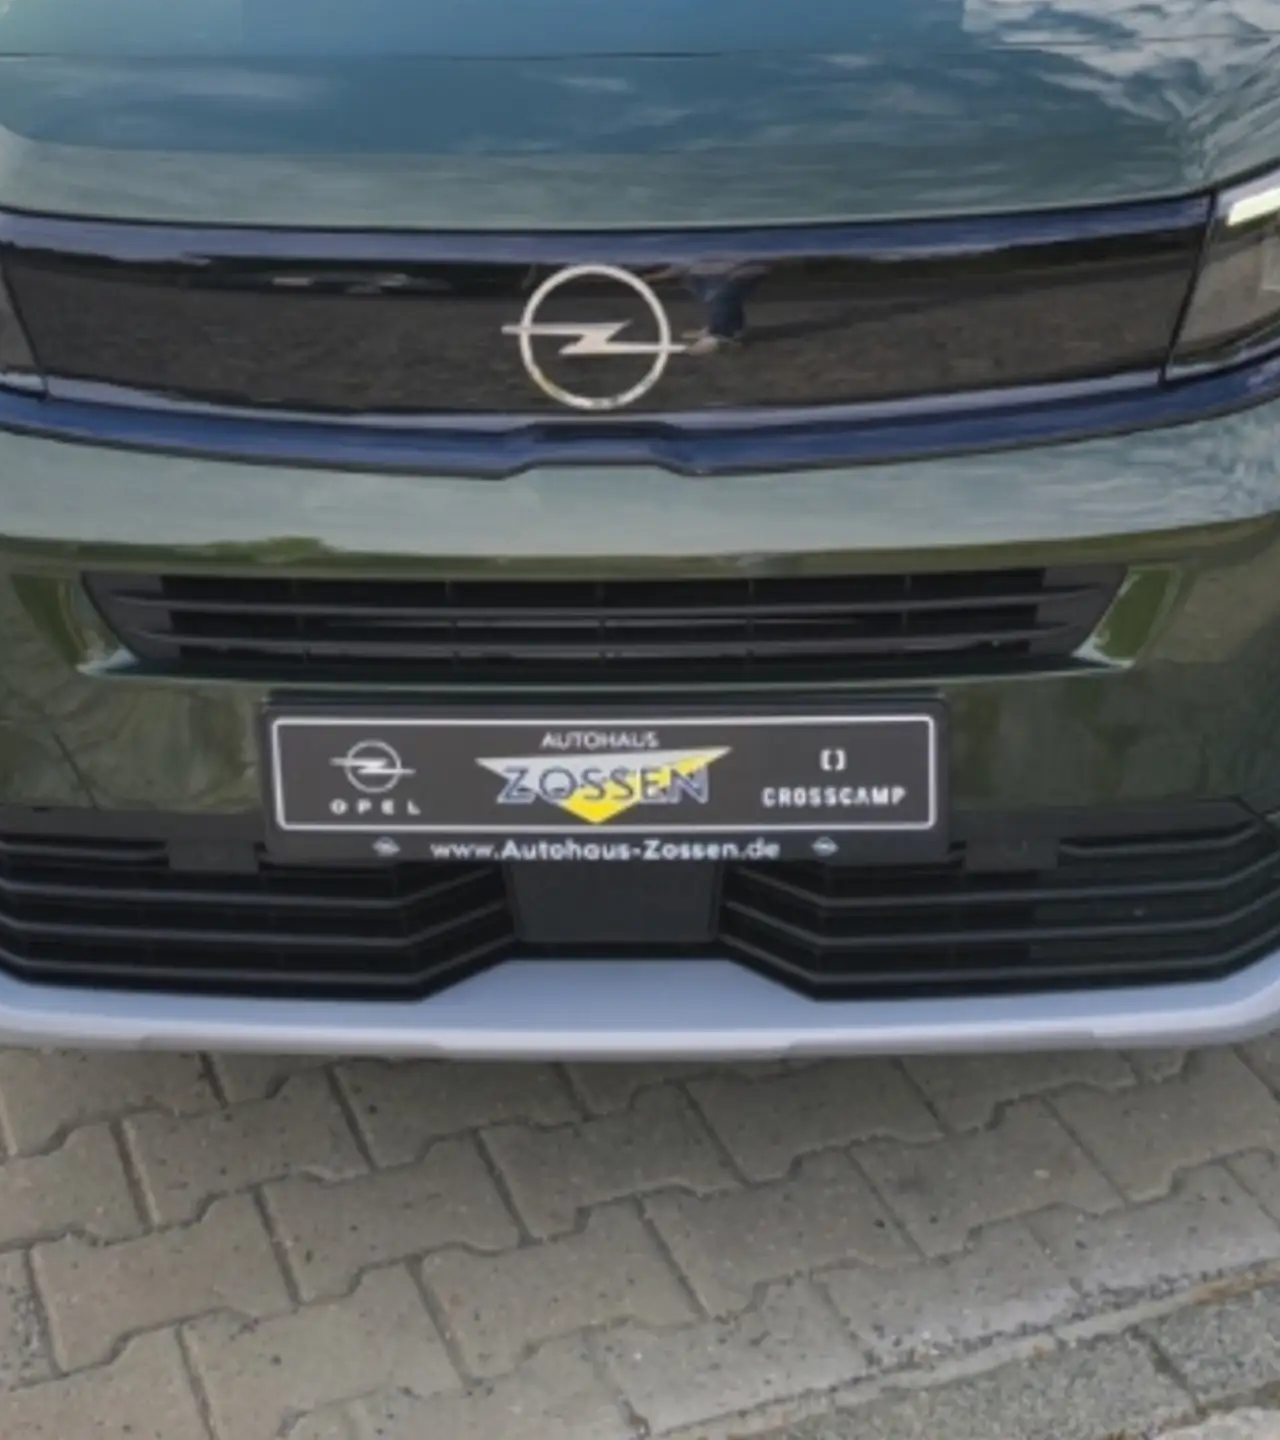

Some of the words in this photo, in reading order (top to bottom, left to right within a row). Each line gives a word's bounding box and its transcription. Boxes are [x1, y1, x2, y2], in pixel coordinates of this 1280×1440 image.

[540, 731, 660, 749] AUTOHAUS
[496, 765, 709, 805] ZOSSEN
[329, 798, 421, 815] OPEL
[761, 786, 907, 808] CROSSCAMP
[429, 837, 782, 860] www.Autohaus-Zossen.de
